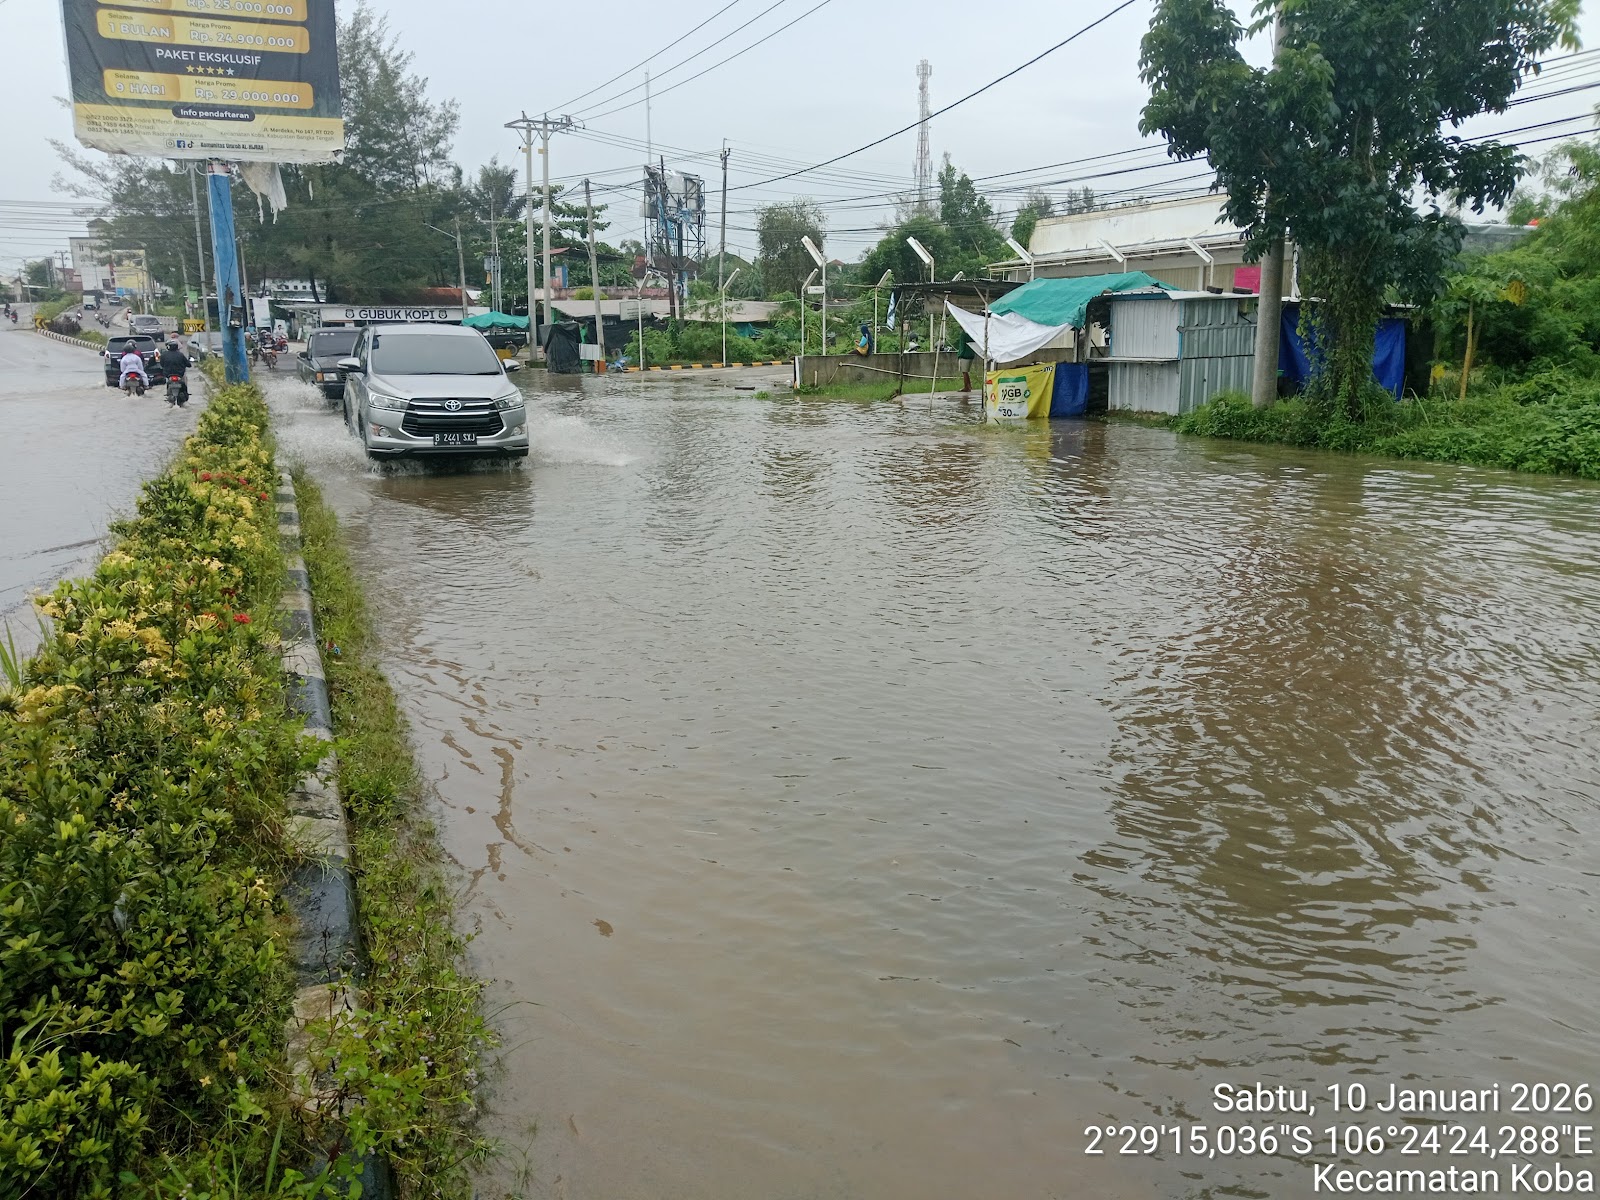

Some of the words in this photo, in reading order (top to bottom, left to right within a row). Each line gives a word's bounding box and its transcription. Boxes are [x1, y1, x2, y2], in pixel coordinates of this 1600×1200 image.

[109, 22, 116, 33] 1
[120, 24, 170, 38] BULAN
[189, 21, 210, 29] Harga
[190, 30, 213, 43] Rp.
[217, 33, 294, 47] 24.900.000
[155, 48, 196, 61] PAKET
[198, 51, 262, 65] EKSKLUSIF
[115, 82, 125, 92] 9
[130, 83, 165, 95] HARI
[195, 79, 215, 87] Harga
[195, 88, 218, 100] Rp.
[222, 90, 299, 103] 29.000.000
[180, 109, 198, 117] Info
[198, 110, 250, 120] pendaftaran
[359, 309, 402, 320] GUBUK
[404, 309, 435, 320] KOPI
[435, 433, 440, 442] B
[443, 433, 460, 442] 2441
